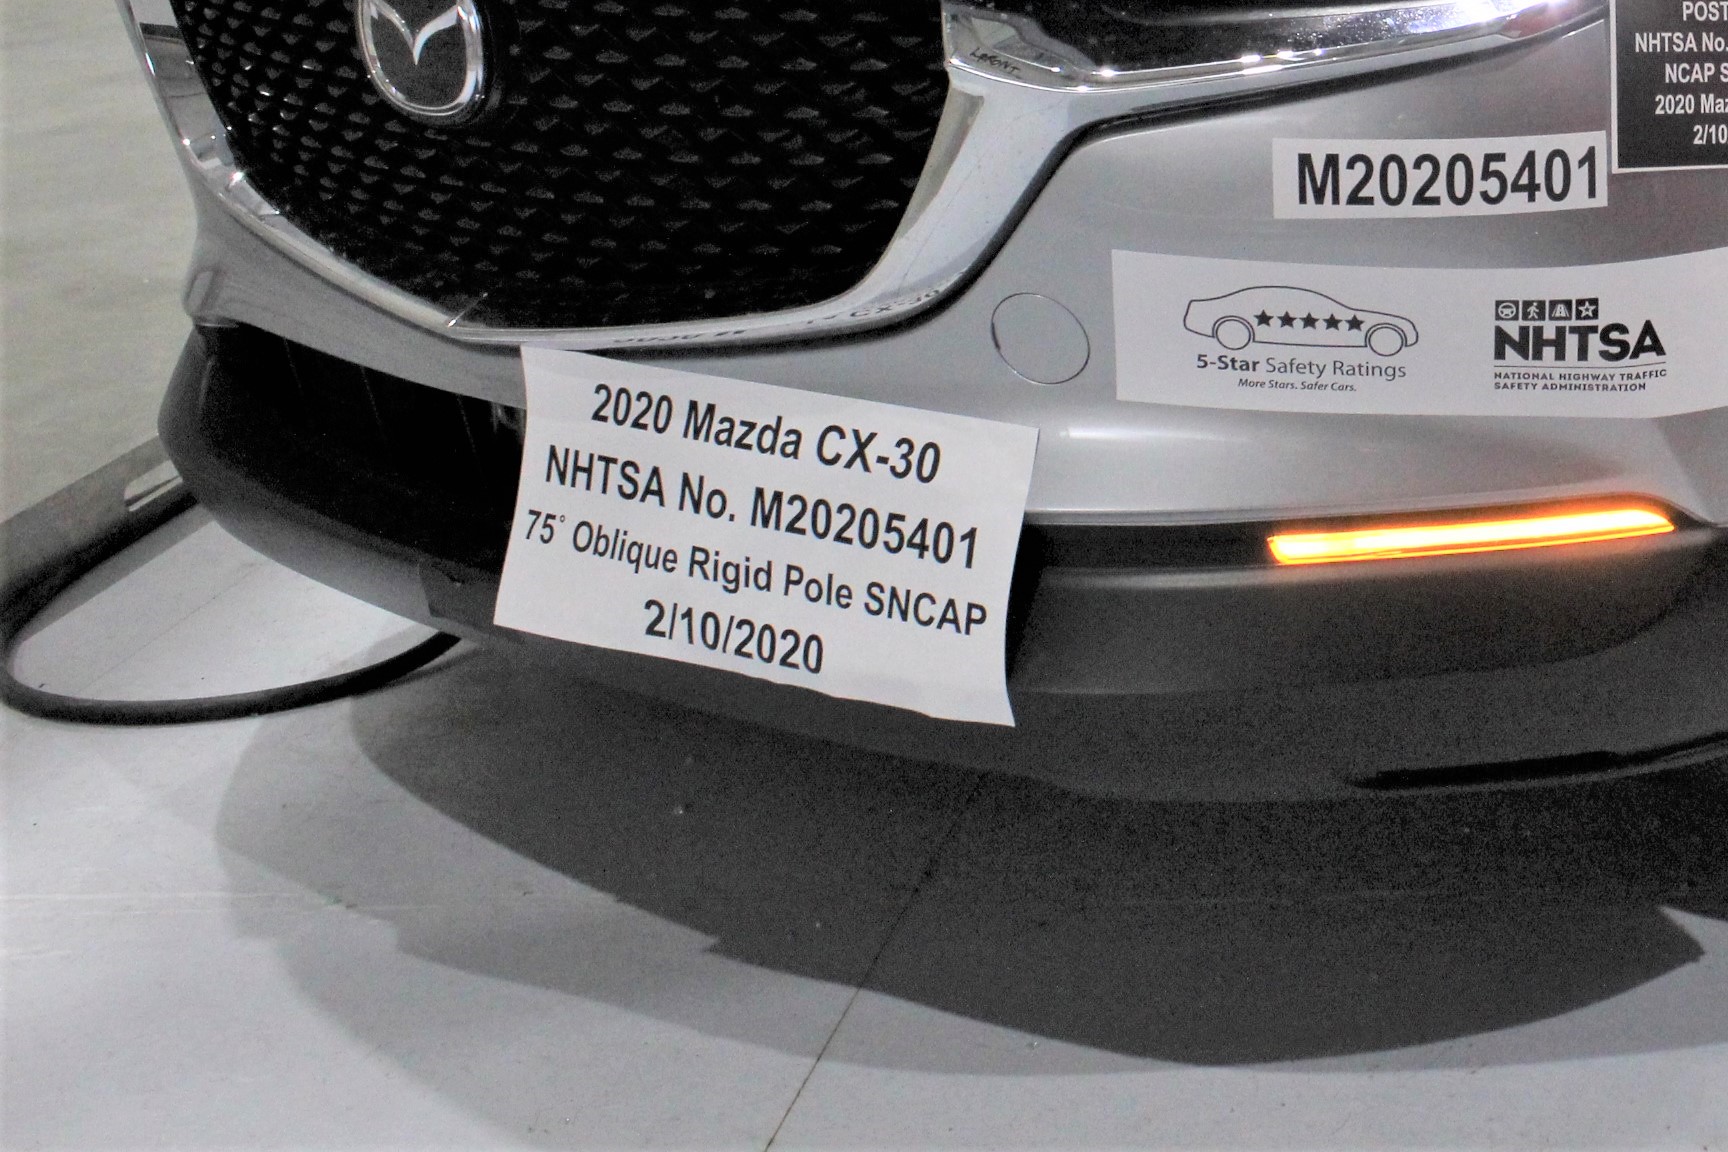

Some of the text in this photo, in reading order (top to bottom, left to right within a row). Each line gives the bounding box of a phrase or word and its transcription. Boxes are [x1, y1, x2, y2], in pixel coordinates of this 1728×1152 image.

[1635, 31, 1698, 53] NHTSA
[1665, 62, 1716, 84] NCAP
[1654, 93, 1695, 115] 2020
[1298, 146, 1597, 206] M20205401
[1493, 319, 1666, 362] NHTSA
[1197, 353, 1407, 382] 5-Star Safety Ratings
[1494, 369, 1667, 381] NATIONAL HIGHWAY TRAFFIC
[1238, 378, 1357, 392] More Stars. Safer Cars.
[1494, 382, 1646, 392] SAFETY ADMINISTRATION
[591, 383, 941, 484] 2020 Mazda CX-30
[545, 444, 977, 569] NHTSA No. M20205401
[572, 520, 678, 574] Oblique
[688, 545, 772, 594] Rigid
[783, 563, 853, 609] Pole
[864, 581, 987, 636] SNCAP
[644, 599, 824, 674] 2/10/2020
